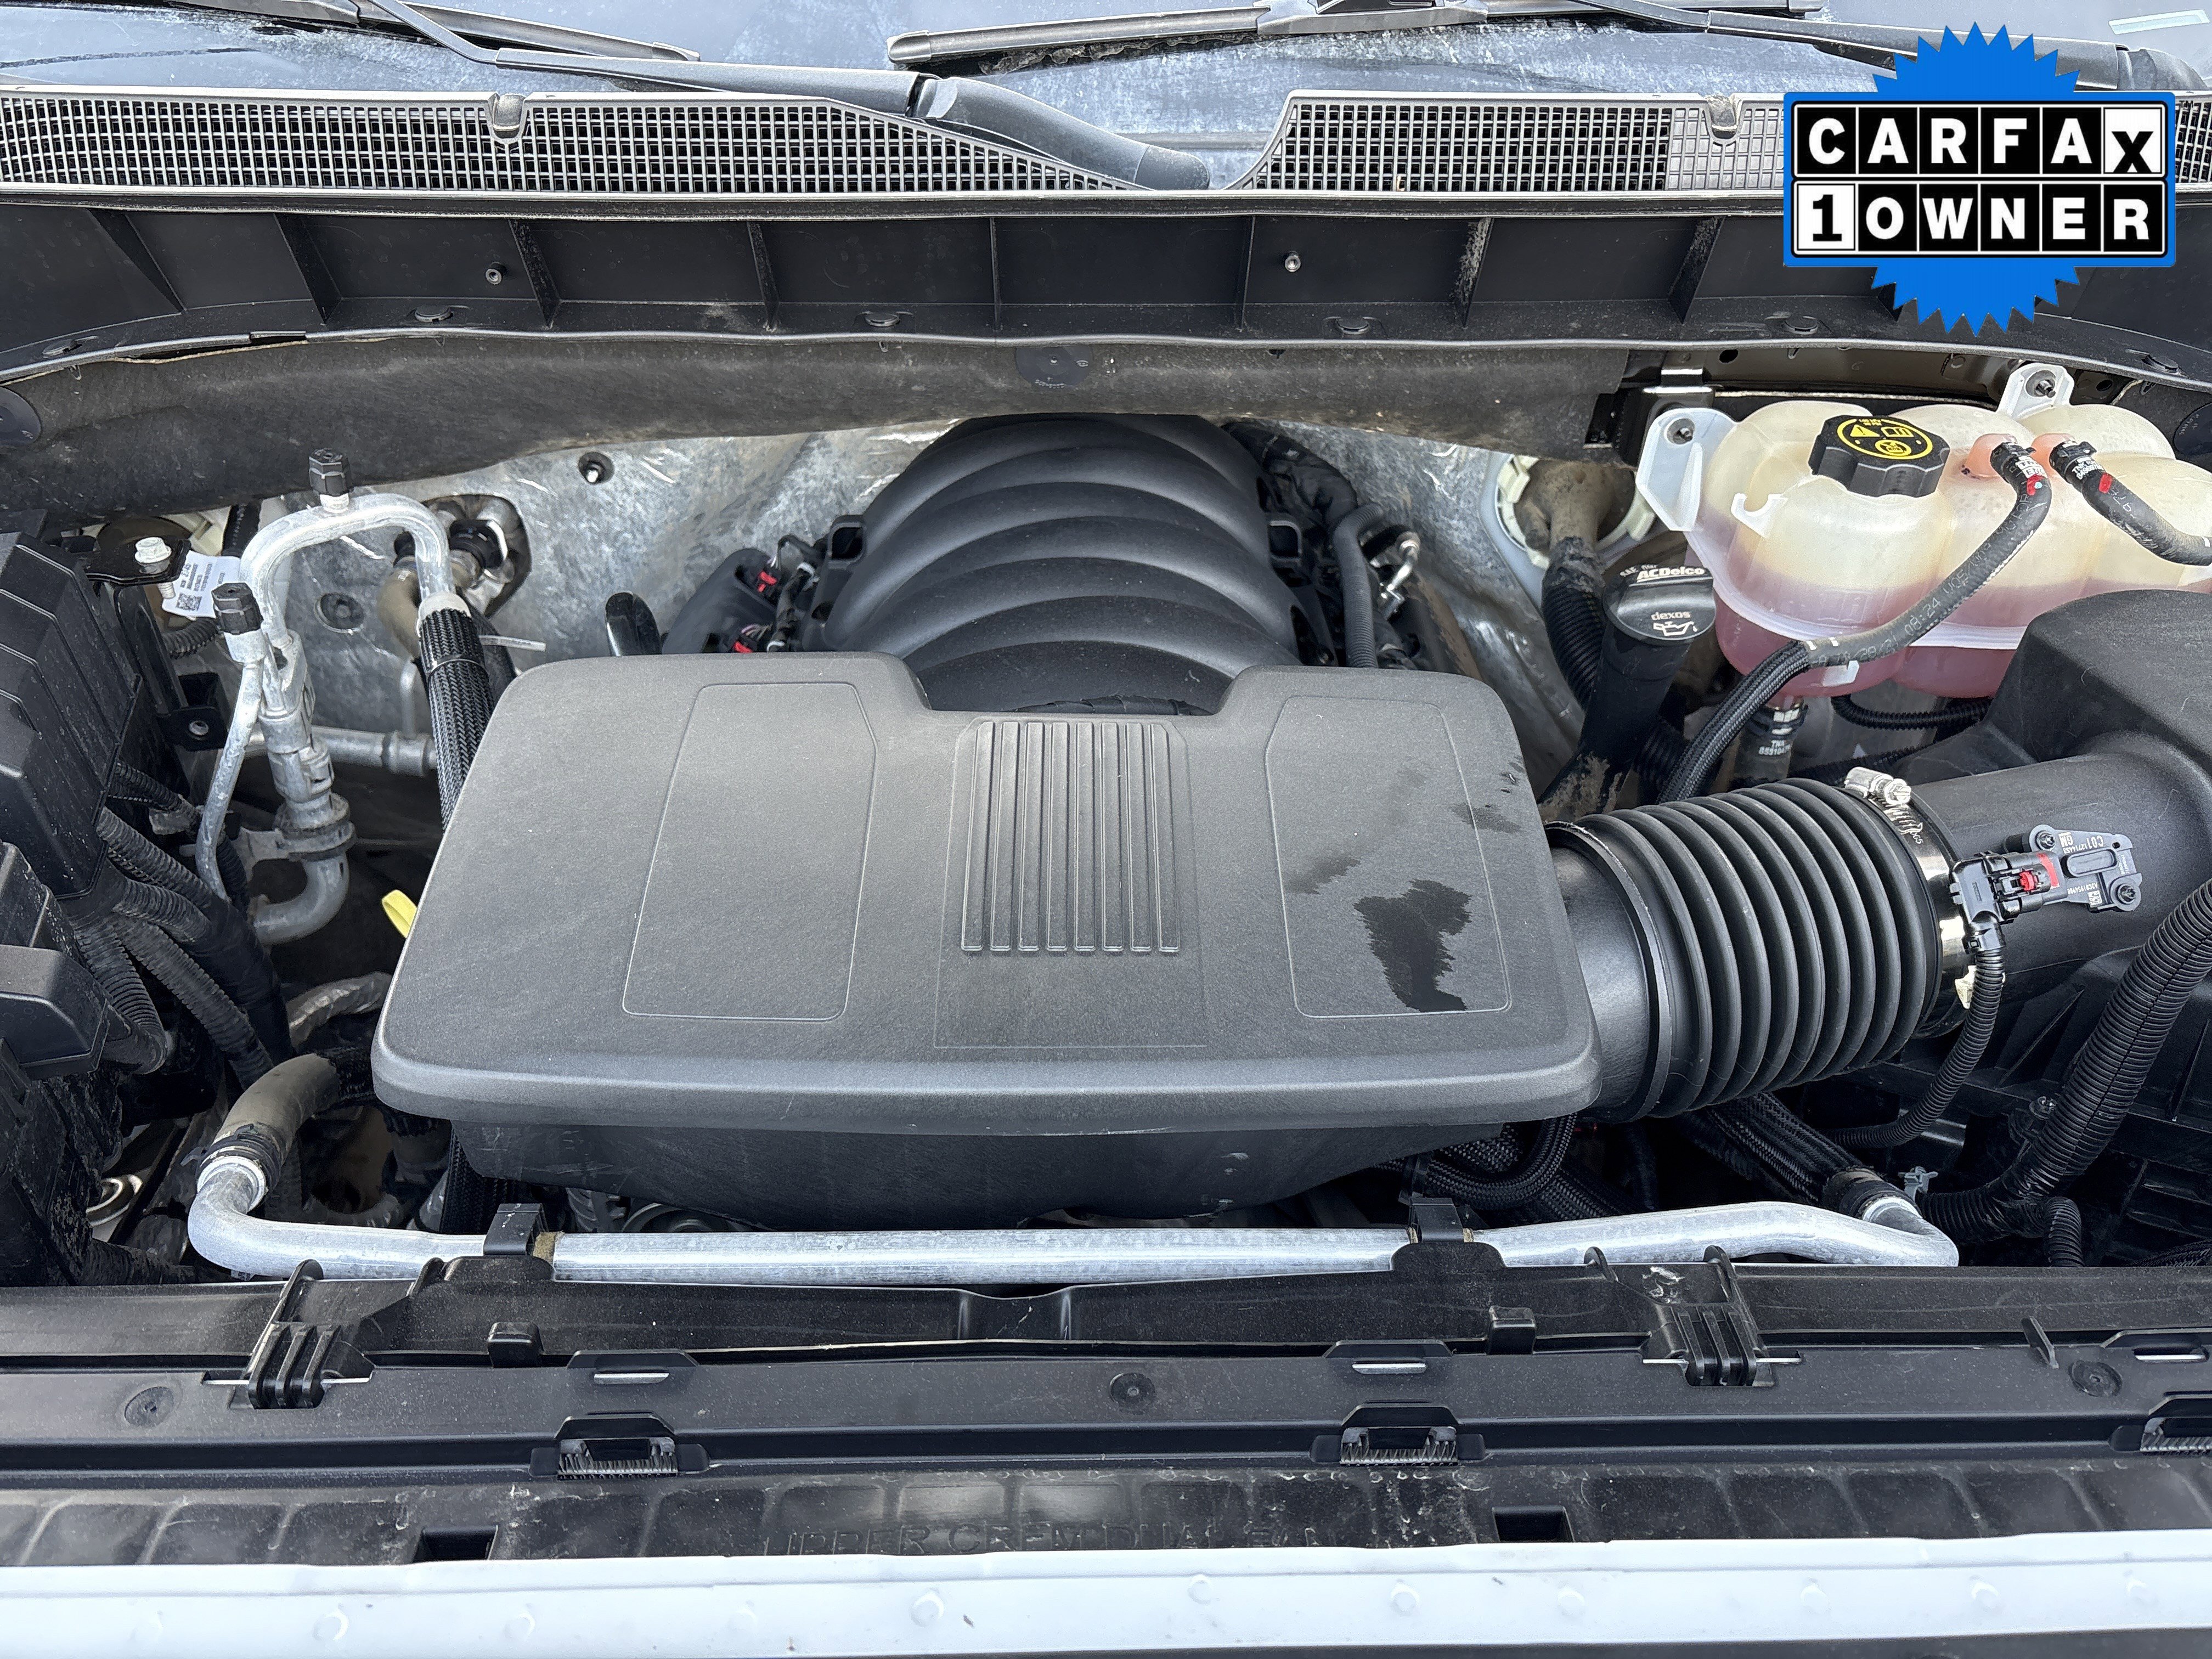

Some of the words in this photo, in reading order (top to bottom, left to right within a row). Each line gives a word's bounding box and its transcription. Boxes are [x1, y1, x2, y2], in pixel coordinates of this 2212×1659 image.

[1637, 566, 1705, 580] ACDelco
[1651, 612, 1691, 620] dexos
[2059, 834, 2074, 848] GM
[2086, 835, 2104, 850] C01
